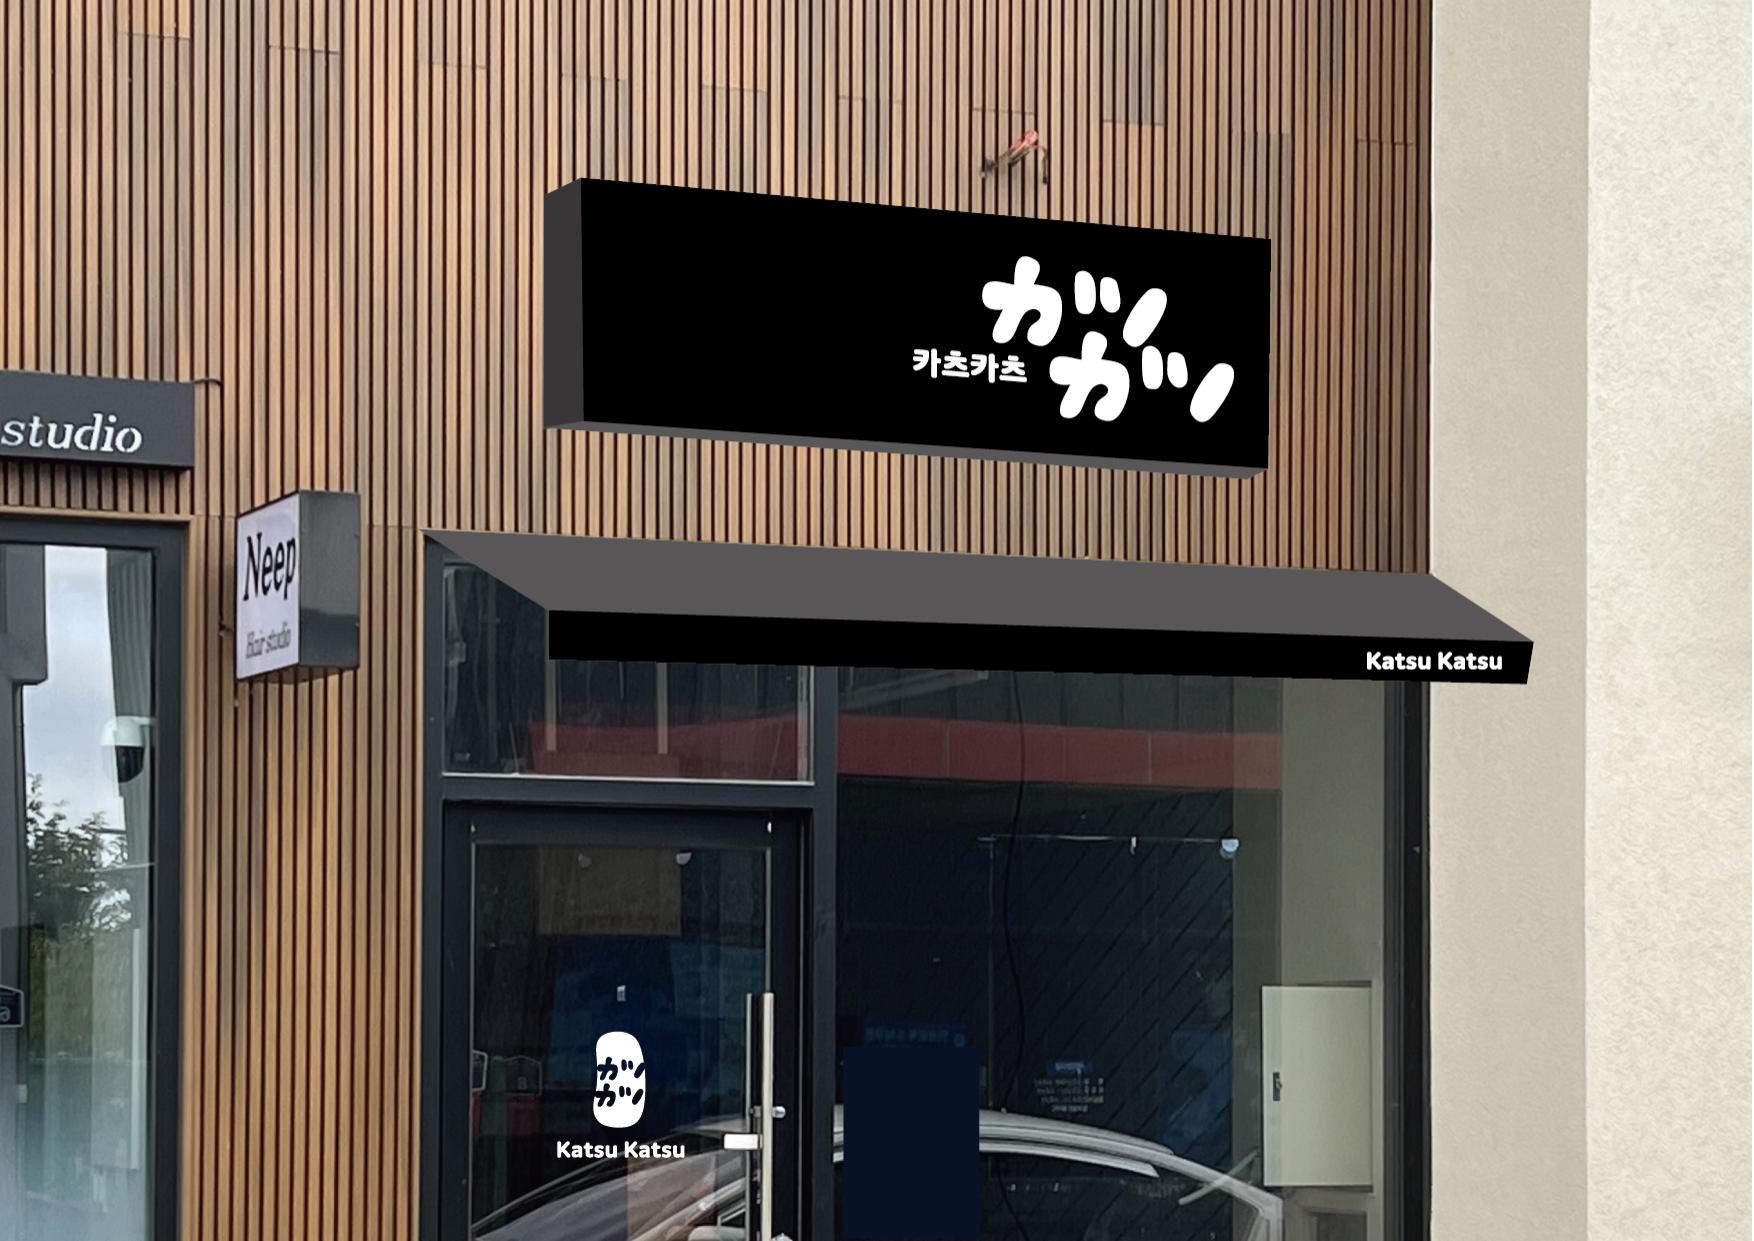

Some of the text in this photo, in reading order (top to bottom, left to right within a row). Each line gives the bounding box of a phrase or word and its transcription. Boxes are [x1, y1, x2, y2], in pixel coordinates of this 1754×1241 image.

[912, 348, 1028, 383] 카츠카츠
[1, 413, 142, 453] studio
[243, 532, 296, 601] Neep
[265, 621, 291, 653] studio
[1366, 651, 1503, 670] Katsu Katsu
[556, 1141, 685, 1158] Katsu Katsu
